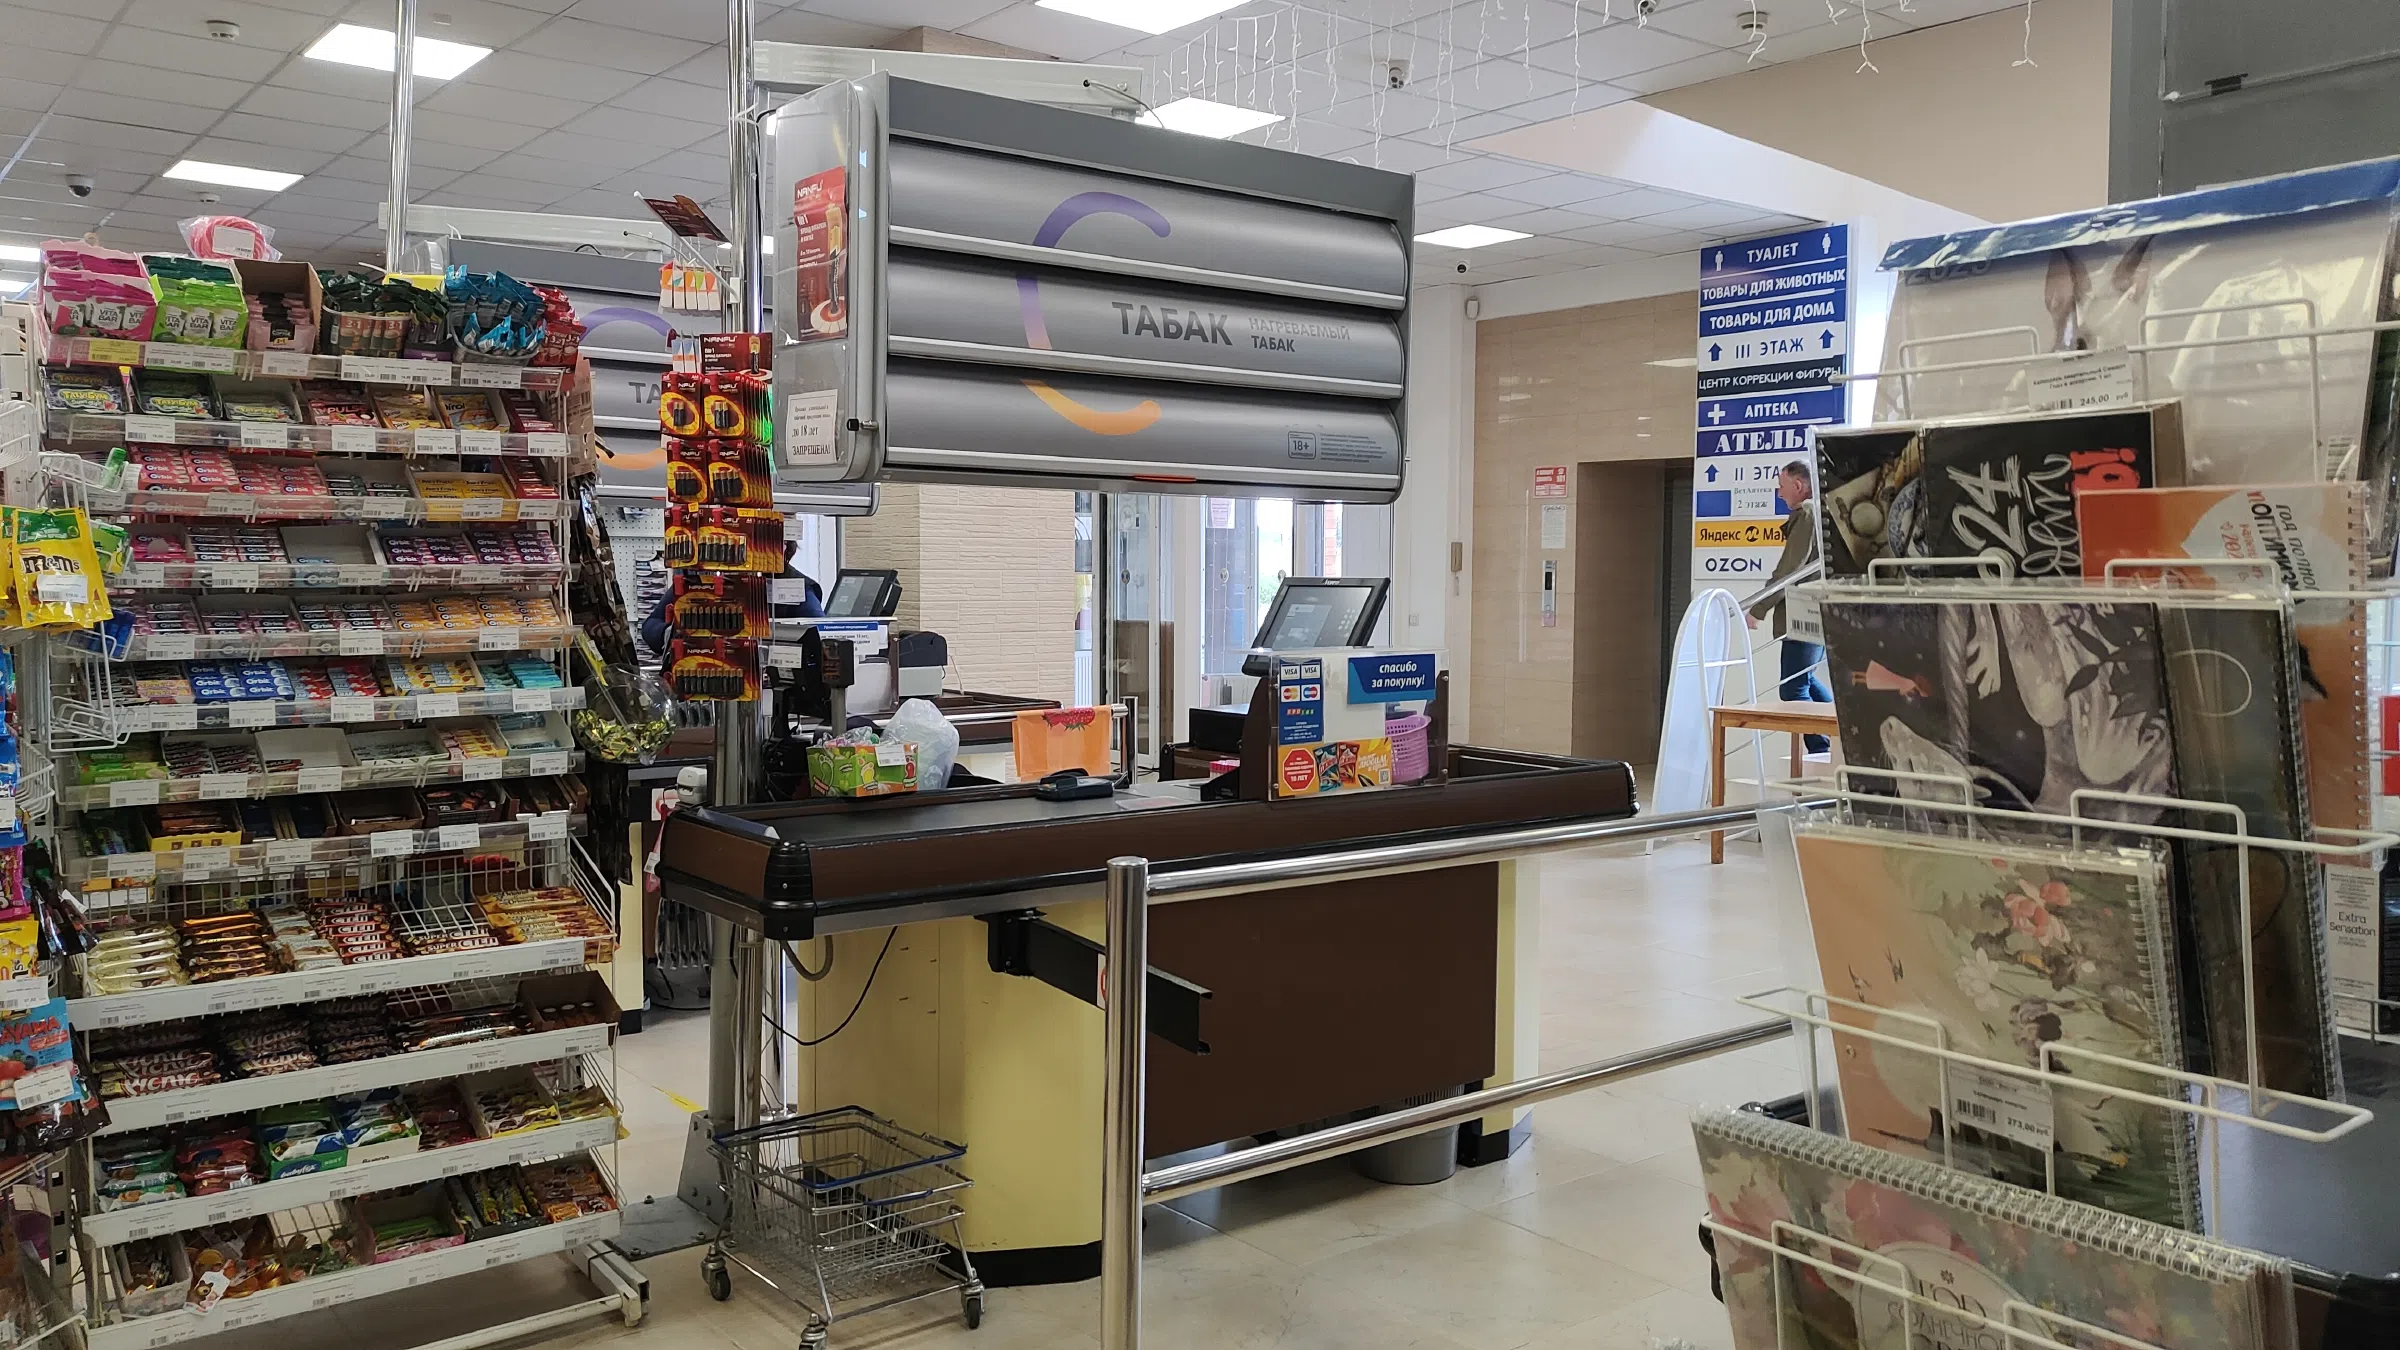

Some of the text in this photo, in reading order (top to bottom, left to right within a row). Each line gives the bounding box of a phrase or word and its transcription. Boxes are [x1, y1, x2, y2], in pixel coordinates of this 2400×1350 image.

[797, 178, 823, 199] NANFU
[1747, 243, 1799, 263] ТУАЛЕТ
[1703, 269, 1845, 300] ТОВАРЫ ДЛЯ ЖИВОТНЫХ
[100, 309, 119, 317] VITA
[1710, 301, 1834, 329] ТОВАРЫ ДЛЯ ДОМА
[98, 315, 119, 323] BAR
[190, 316, 209, 324] VITA
[1112, 301, 1232, 346] ТАБАК
[190, 322, 209, 330] BAR
[1249, 316, 1350, 341] НАГРЕВАЕМЫЙ
[703, 335, 738, 343] NANFU
[1251, 335, 1295, 353] ТАБАК
[1736, 337, 1804, 359] III ЭТАЖ
[1699, 367, 1841, 389] ЦЕНТР КОРРЕКЦИИ ФИГУРЫ
[2080, 394, 2110, 406] 245,00
[1745, 401, 1798, 418] АПТЕКА
[792, 425, 819, 438] до 18 лет
[792, 444, 831, 456] ЗАПРЕЩЕНА!
[1293, 440, 1310, 451] 18+
[146, 464, 170, 472] Orbit
[1754, 465, 1780, 480] ЭТА
[285, 485, 309, 493] Orbit
[1737, 500, 1742, 508] 2
[1700, 528, 1741, 542] Яндекс
[199, 554, 222, 562] Orbit
[249, 554, 270, 562] Orbit
[1705, 558, 1762, 572] OZON
[485, 611, 505, 619] Orbit
[403, 622, 425, 630] Orbit
[445, 621, 466, 629] Orbit
[488, 619, 509, 627] Orbit
[1284, 667, 1298, 676] VISA
[1304, 666, 1317, 674] VISA
[1379, 660, 1417, 674] спасибо
[195, 679, 221, 687] Orbit
[1371, 674, 1425, 689] за покупку!
[201, 688, 226, 696] Orbit
[249, 686, 274, 694] Orbit
[2338, 911, 2366, 925] Extra
[2329, 921, 2376, 937] Sensation
[419, 933, 448, 941] SUPER
[427, 942, 458, 951] SUPER
